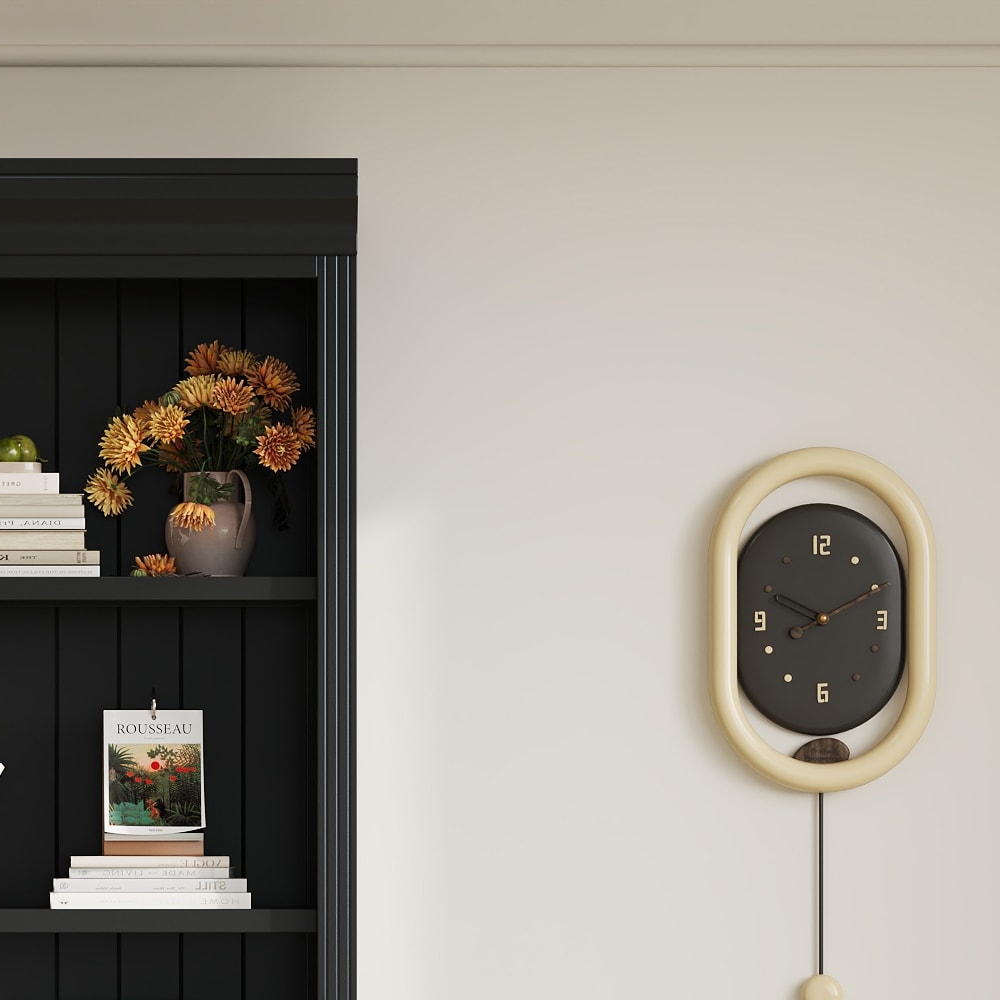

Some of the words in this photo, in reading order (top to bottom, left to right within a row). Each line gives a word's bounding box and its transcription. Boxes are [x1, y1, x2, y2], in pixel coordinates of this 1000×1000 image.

[812, 534, 831, 555] 12
[754, 610, 766, 631] 9
[876, 610, 888, 630] 3
[817, 683, 829, 703] 6
[117, 724, 192, 735] ROUSSEAU
